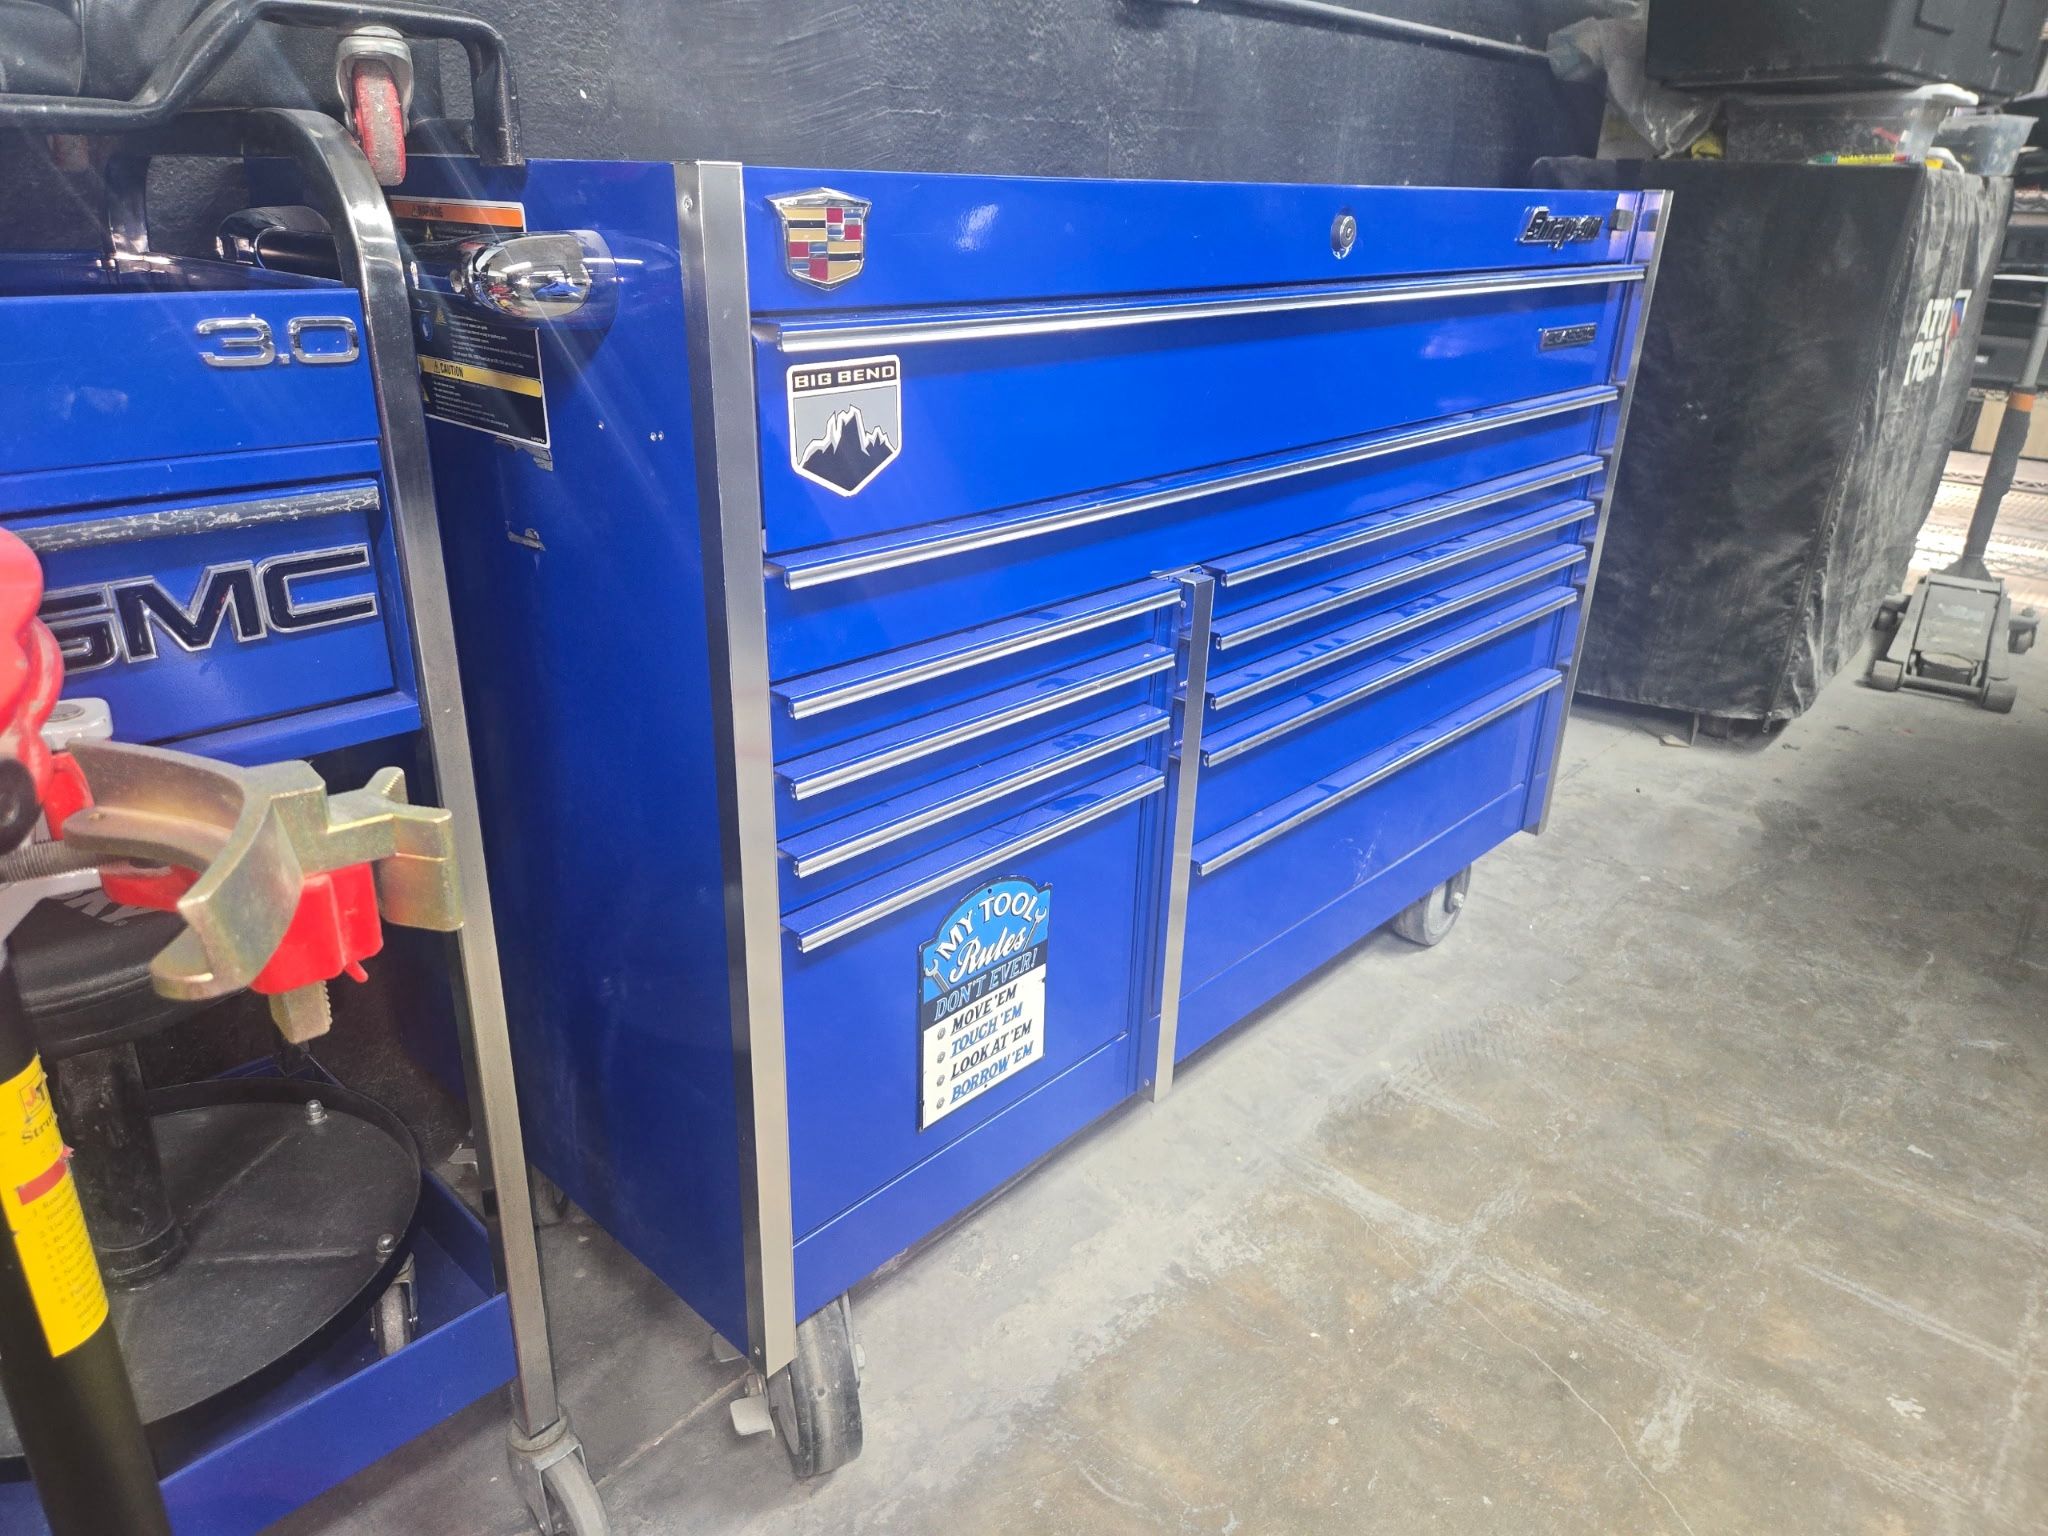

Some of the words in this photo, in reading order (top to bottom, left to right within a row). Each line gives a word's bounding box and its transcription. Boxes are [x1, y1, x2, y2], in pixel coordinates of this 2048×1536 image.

[194, 314, 360, 367] 3.0
[440, 362, 464, 378] CAUTION
[795, 373, 832, 389] BIG
[837, 365, 896, 384] BEND
[935, 910, 974, 961] MY
[949, 926, 1027, 985] Rules
[935, 974, 986, 1021] DON'T
[989, 947, 1038, 990] EVER!
[951, 998, 993, 1035] MOVE
[994, 983, 1018, 1008] 'EM
[951, 1015, 999, 1057] TOUCH
[1000, 1001, 1024, 1026] 'EM
[951, 1043, 990, 1080] LOOK
[990, 1032, 1009, 1056] AT
[1011, 1019, 1033, 1043] 'EM
[951, 1054, 1011, 1104] BORROW
[1012, 1040, 1034, 1066] 'EM
